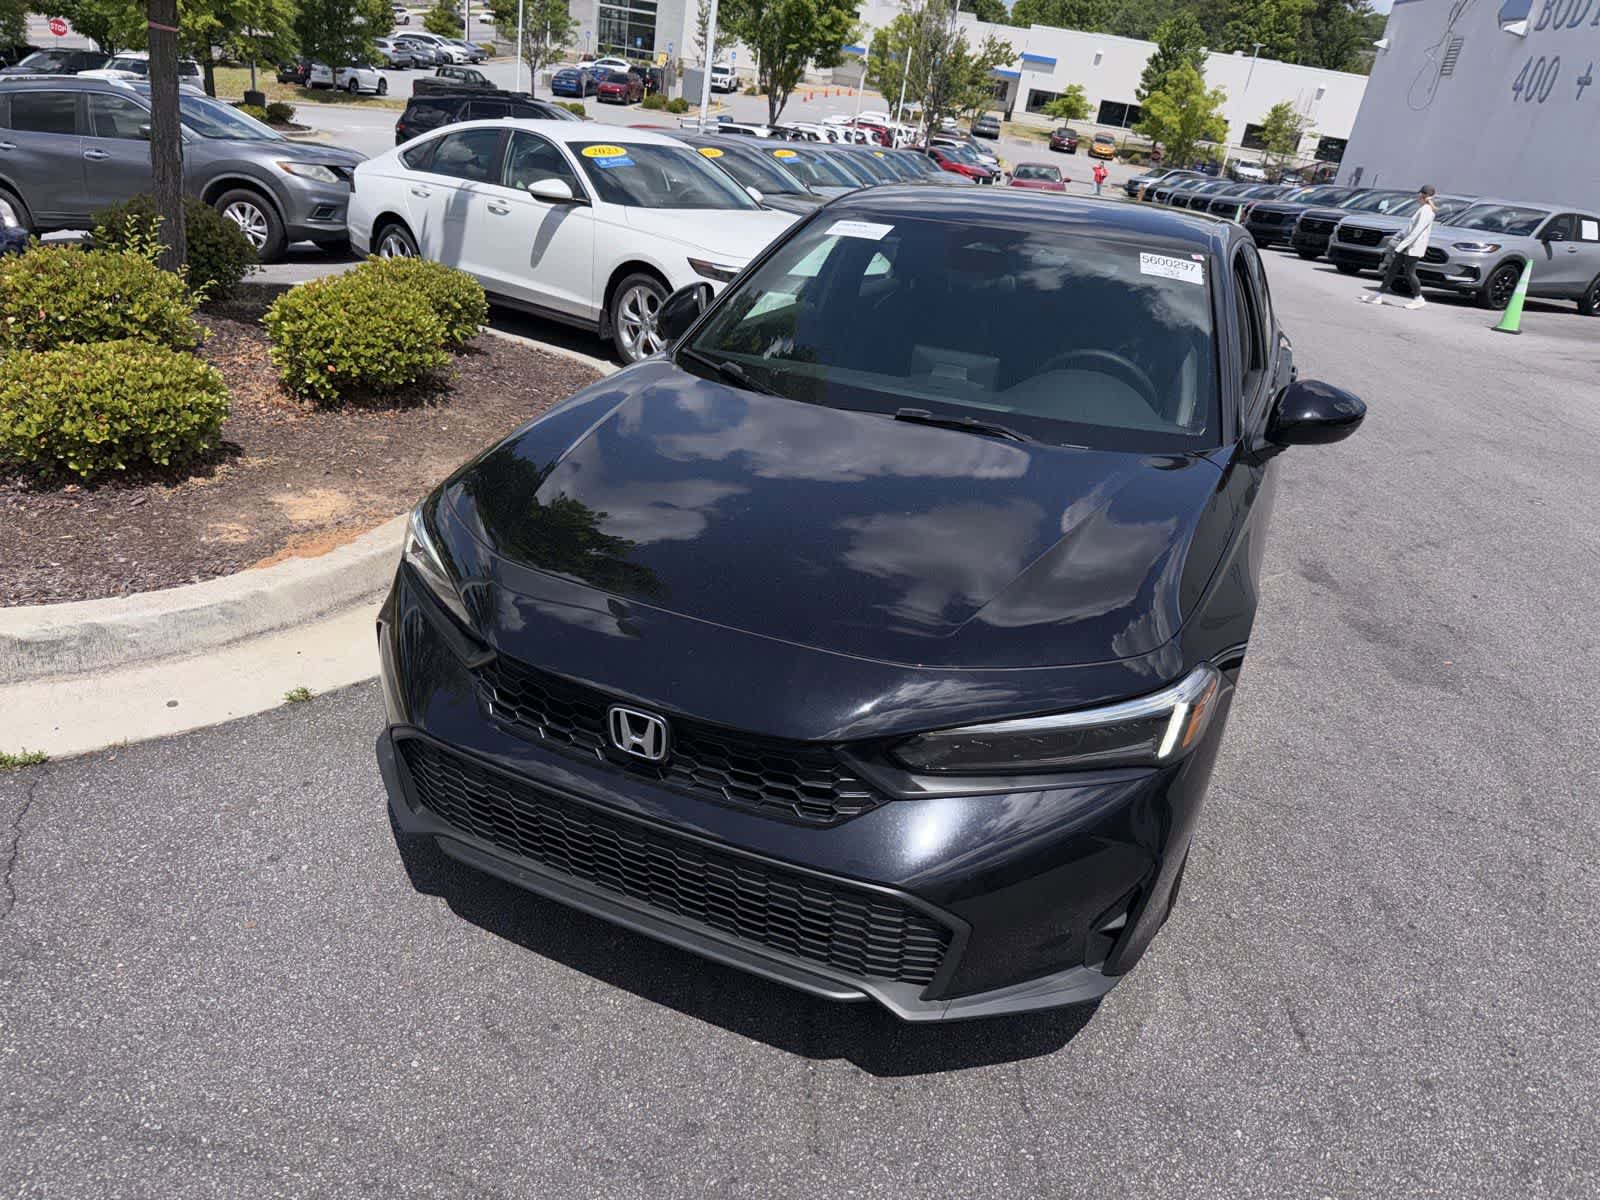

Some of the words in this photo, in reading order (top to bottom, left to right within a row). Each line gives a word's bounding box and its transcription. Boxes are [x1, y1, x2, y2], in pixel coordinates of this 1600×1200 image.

[50, 22, 67, 32] STOP
[1534, 0, 1600, 31] BOD
[1512, 55, 1560, 104] 400
[1142, 255, 1196, 271] 5600297
